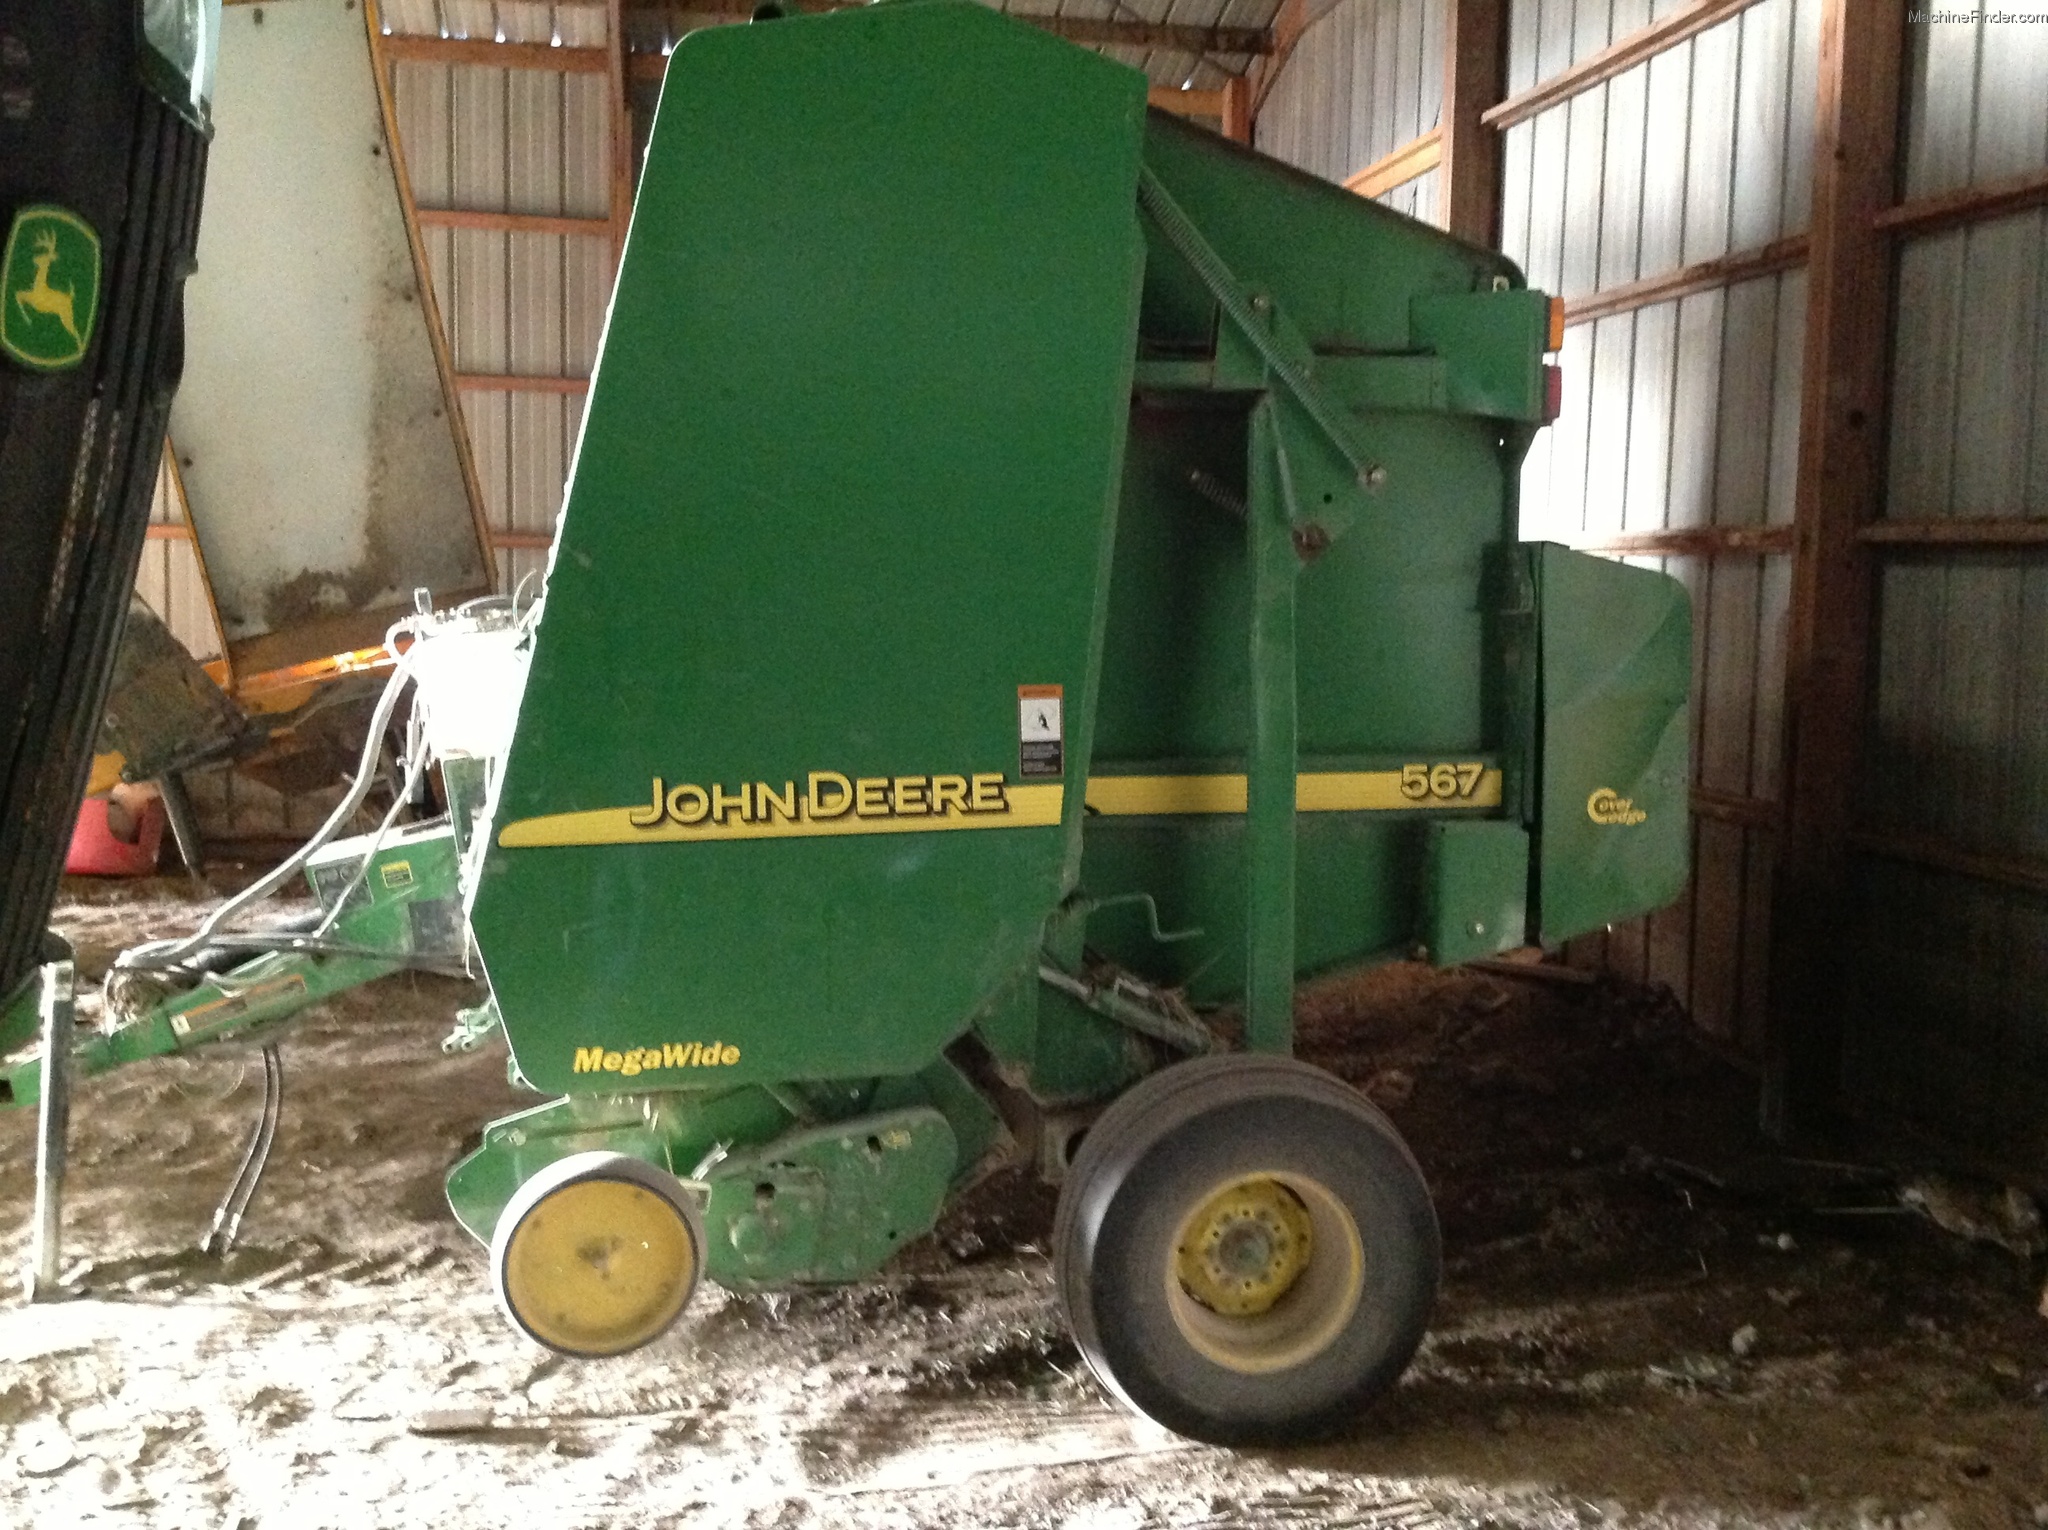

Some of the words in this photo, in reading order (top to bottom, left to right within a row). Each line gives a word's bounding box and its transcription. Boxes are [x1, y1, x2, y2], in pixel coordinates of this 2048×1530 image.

[630, 775, 798, 828] JOHN
[806, 769, 1008, 820] DEERE
[1401, 762, 1484, 799] 567
[573, 1040, 741, 1076] MegaWide
